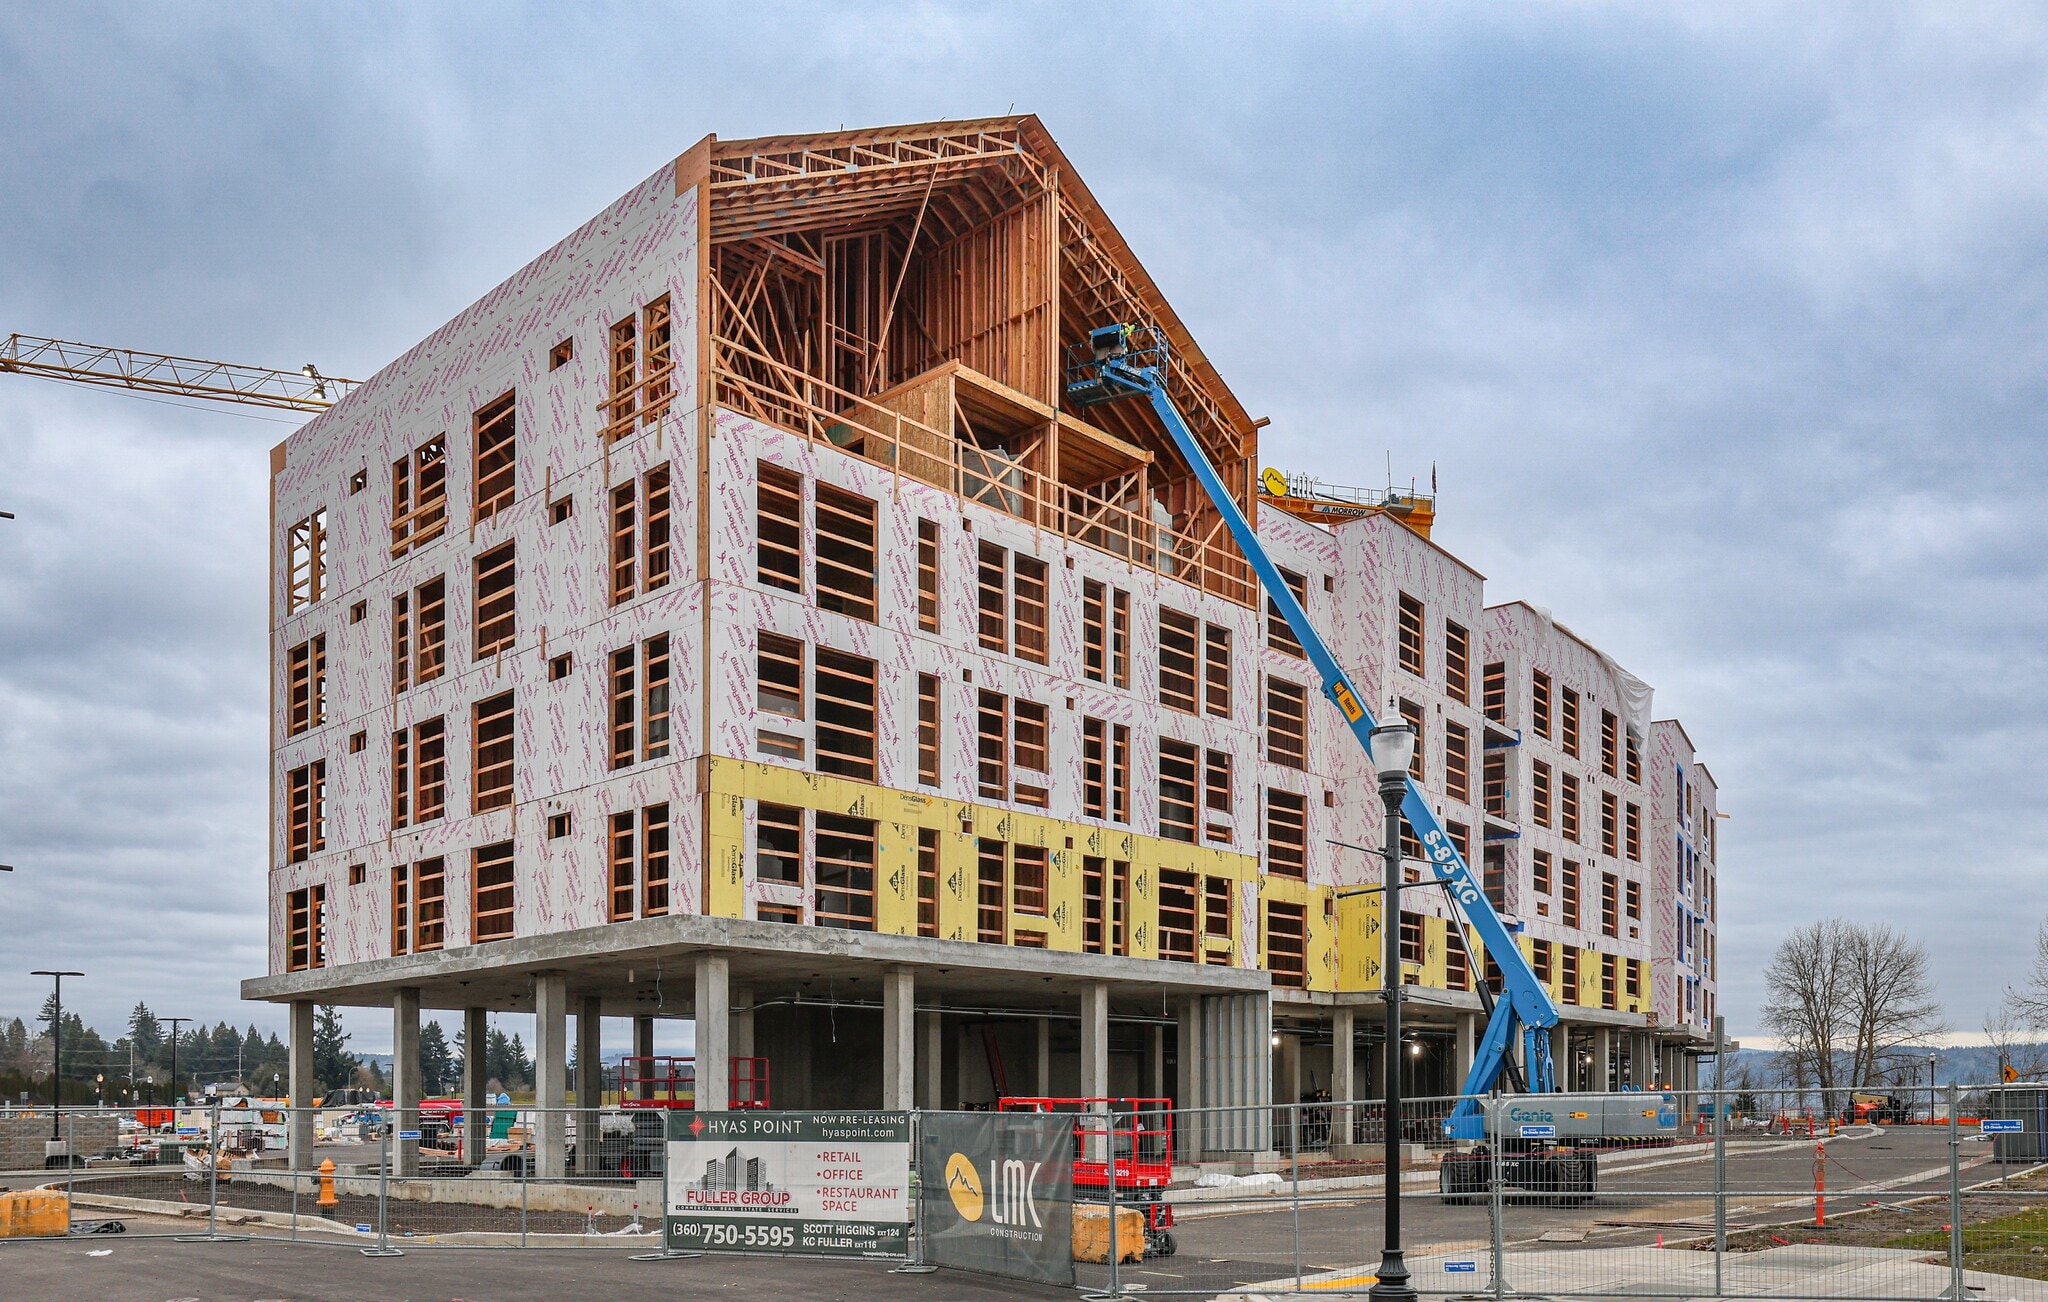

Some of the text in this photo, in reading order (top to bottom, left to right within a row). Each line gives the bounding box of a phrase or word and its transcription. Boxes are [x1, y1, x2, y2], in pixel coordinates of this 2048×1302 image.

[726, 443, 744, 480] GlasRoc
[728, 488, 746, 524] GlasRoc
[1332, 507, 1366, 516] MORROW
[727, 512, 744, 548] GlasRoc
[728, 557, 744, 588] GlasRo
[895, 555, 909, 587] GlasRoc
[730, 657, 748, 692] GlasRoc
[729, 680, 746, 716] GlasRoc
[900, 794, 926, 803] DensGlass
[1424, 830, 1478, 904] S-85 XC
[813, 1116, 904, 1124] NOW PRE-LEASING
[1510, 1108, 1553, 1122] Genie
[708, 1120, 802, 1134] HYAS POINT
[822, 1128, 894, 1138] hyaspoint.com
[823, 1152, 861, 1162] RETAIL
[823, 1170, 862, 1180] OFFICE
[687, 1190, 790, 1205] FULLER GROUP
[822, 1187, 898, 1199] RESTAURANT
[823, 1201, 857, 1211] SPACE
[673, 1222, 794, 1246] (360) 750-5595
[803, 1224, 833, 1234] SCOTT
[836, 1225, 875, 1236] HIGGINS
[990, 1228, 1042, 1242] CONSTRUCTION
[803, 1237, 816, 1246] KC
[818, 1237, 852, 1248] FULLER
